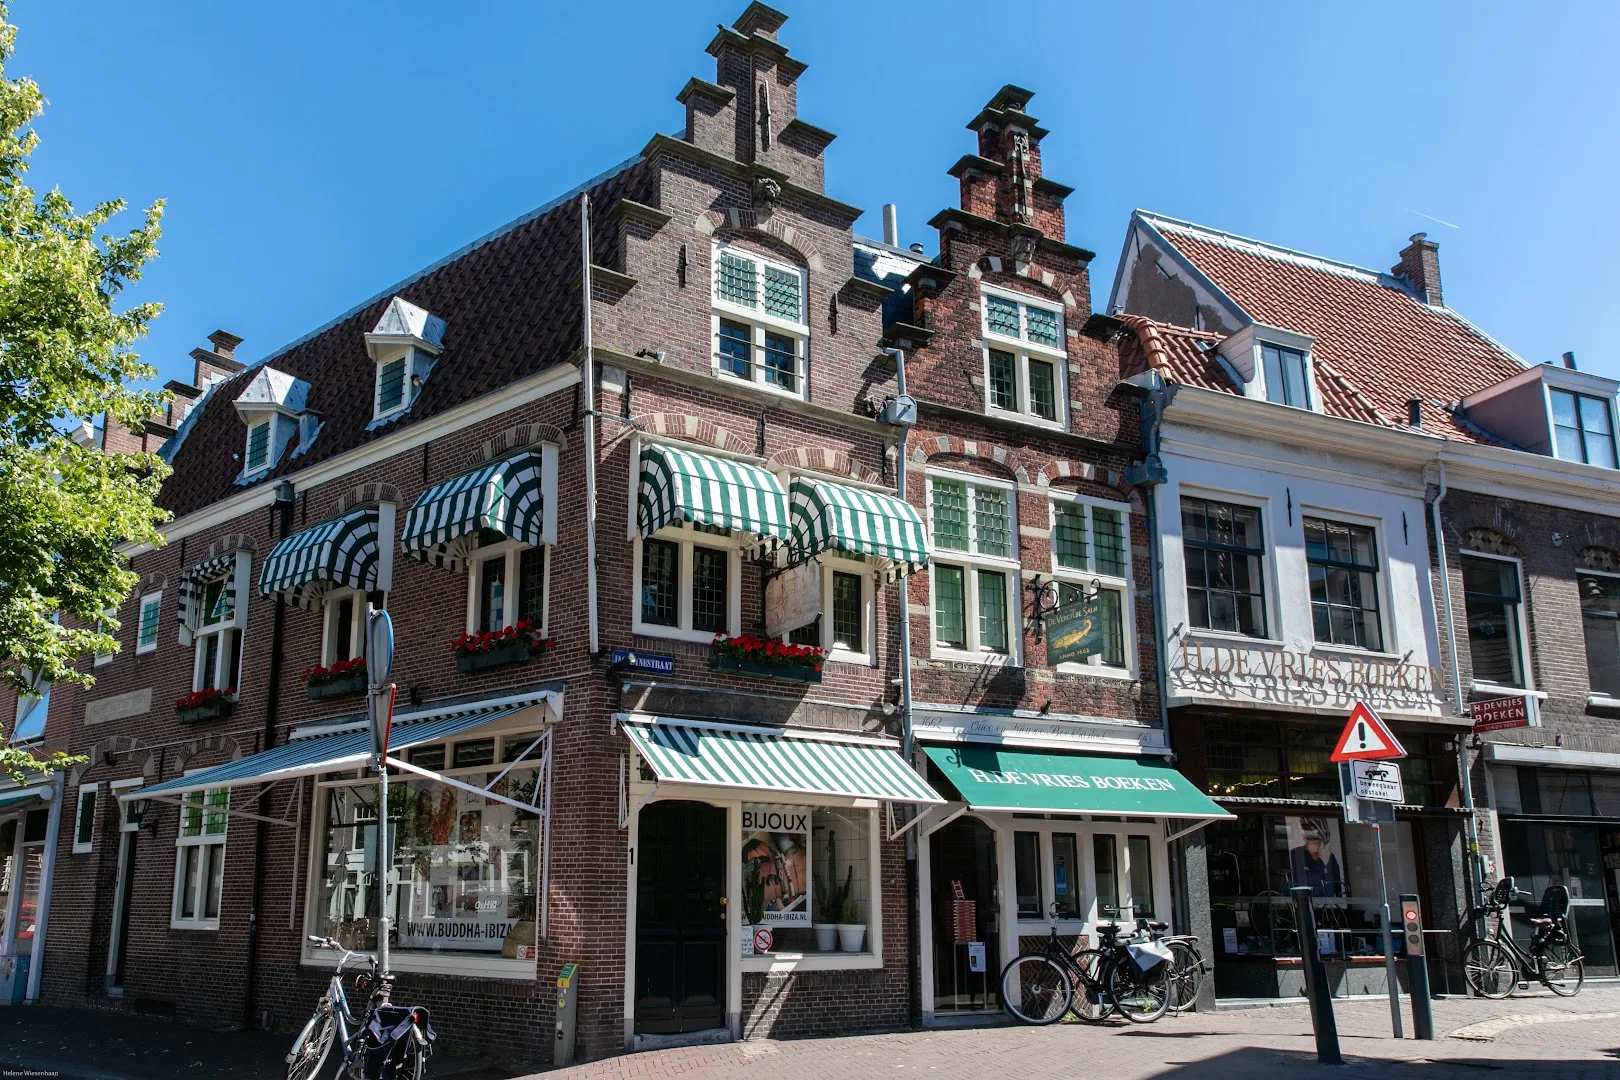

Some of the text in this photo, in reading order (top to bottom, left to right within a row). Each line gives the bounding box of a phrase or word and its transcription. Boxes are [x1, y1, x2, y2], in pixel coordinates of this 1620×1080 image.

[1059, 652, 1075, 660] ANNO
[1257, 650, 1343, 684] VRIES
[1349, 657, 1445, 694] BOEKEN
[1475, 708, 1524, 723] BOEKEN
[1022, 773, 1090, 788] VRIES
[1090, 776, 1176, 791] BOEKEN
[1361, 789, 1388, 797] obstakel
[742, 812, 807, 831] BIJOUX
[629, 847, 634, 865] 1
